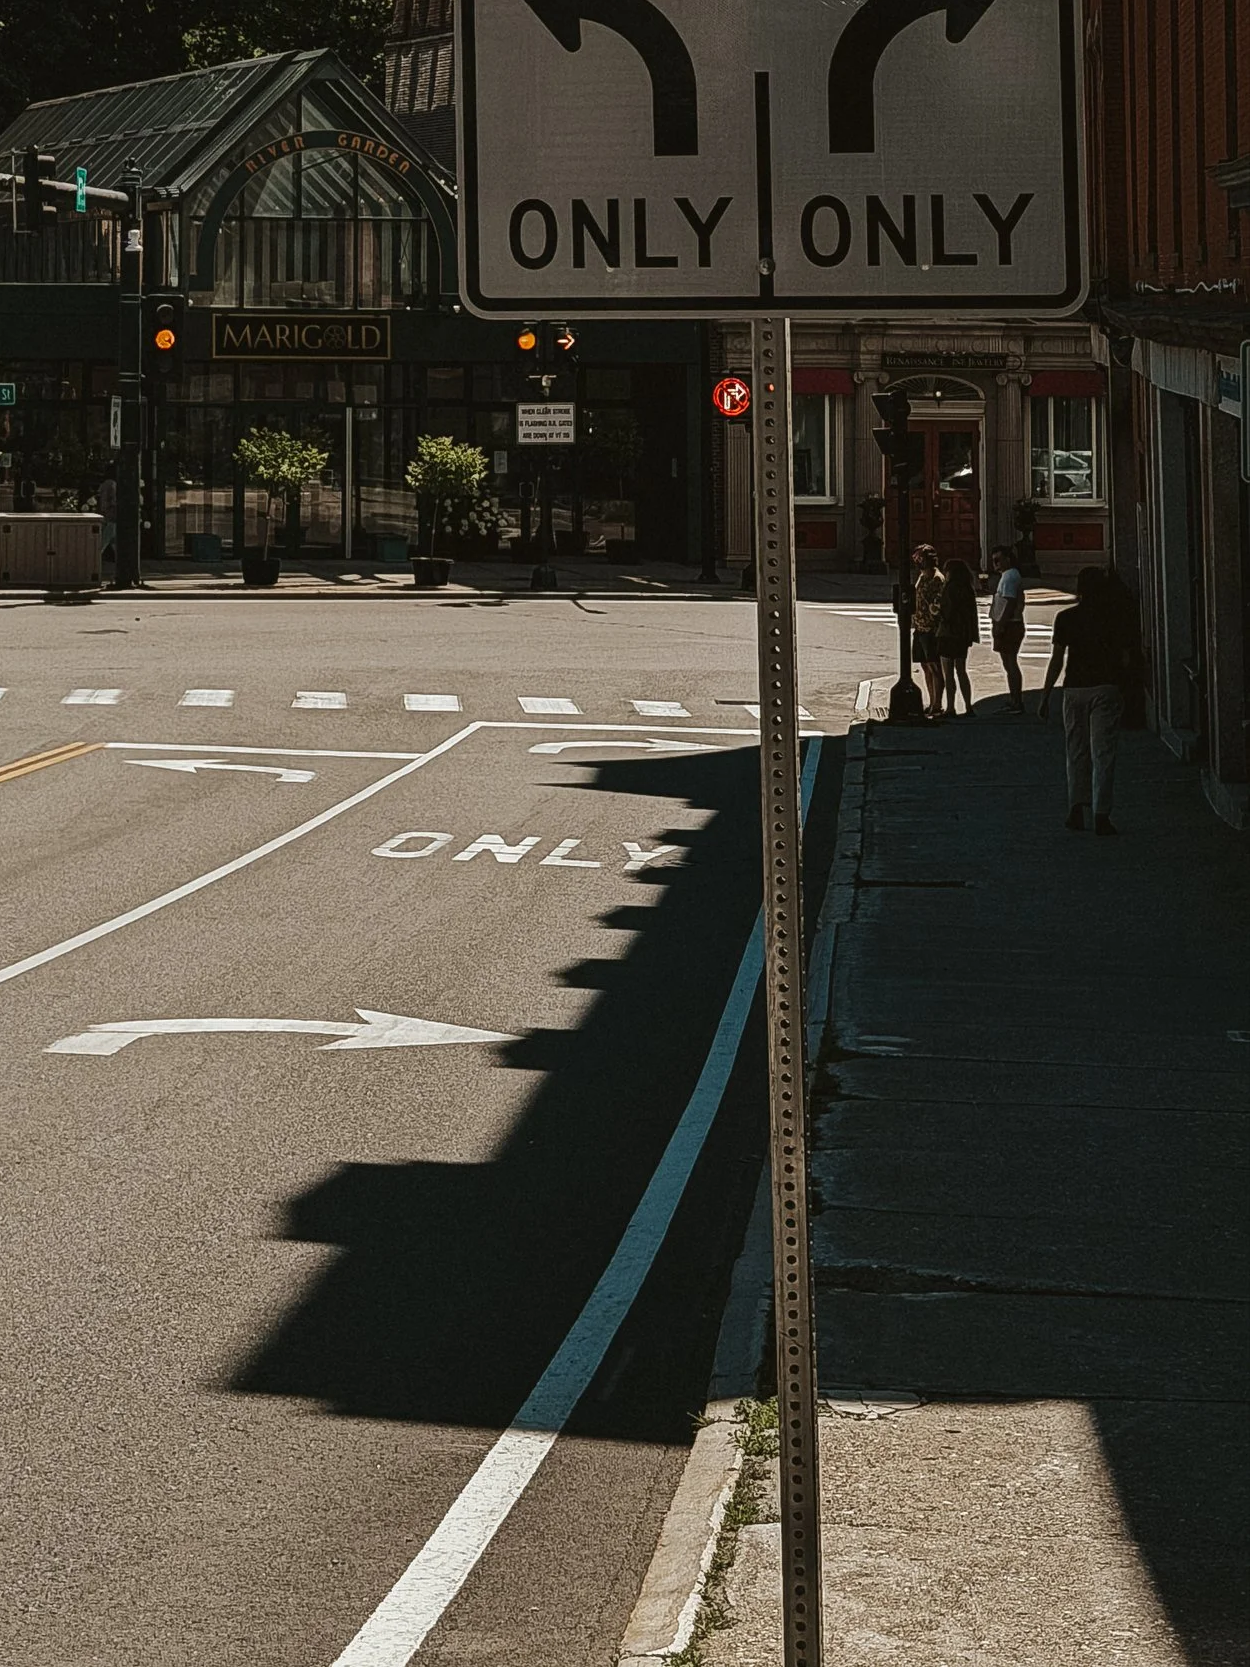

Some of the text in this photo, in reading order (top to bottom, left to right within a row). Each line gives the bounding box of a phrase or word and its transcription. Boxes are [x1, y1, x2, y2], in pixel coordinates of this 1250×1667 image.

[245, 133, 412, 174] RIVER GARDEN
[508, 196, 733, 270] ONLY
[800, 192, 1034, 268] ONLY
[223, 323, 381, 350] MARIGOLD
[1, 388, 11, 400] St
[371, 831, 691, 871] ONLY
